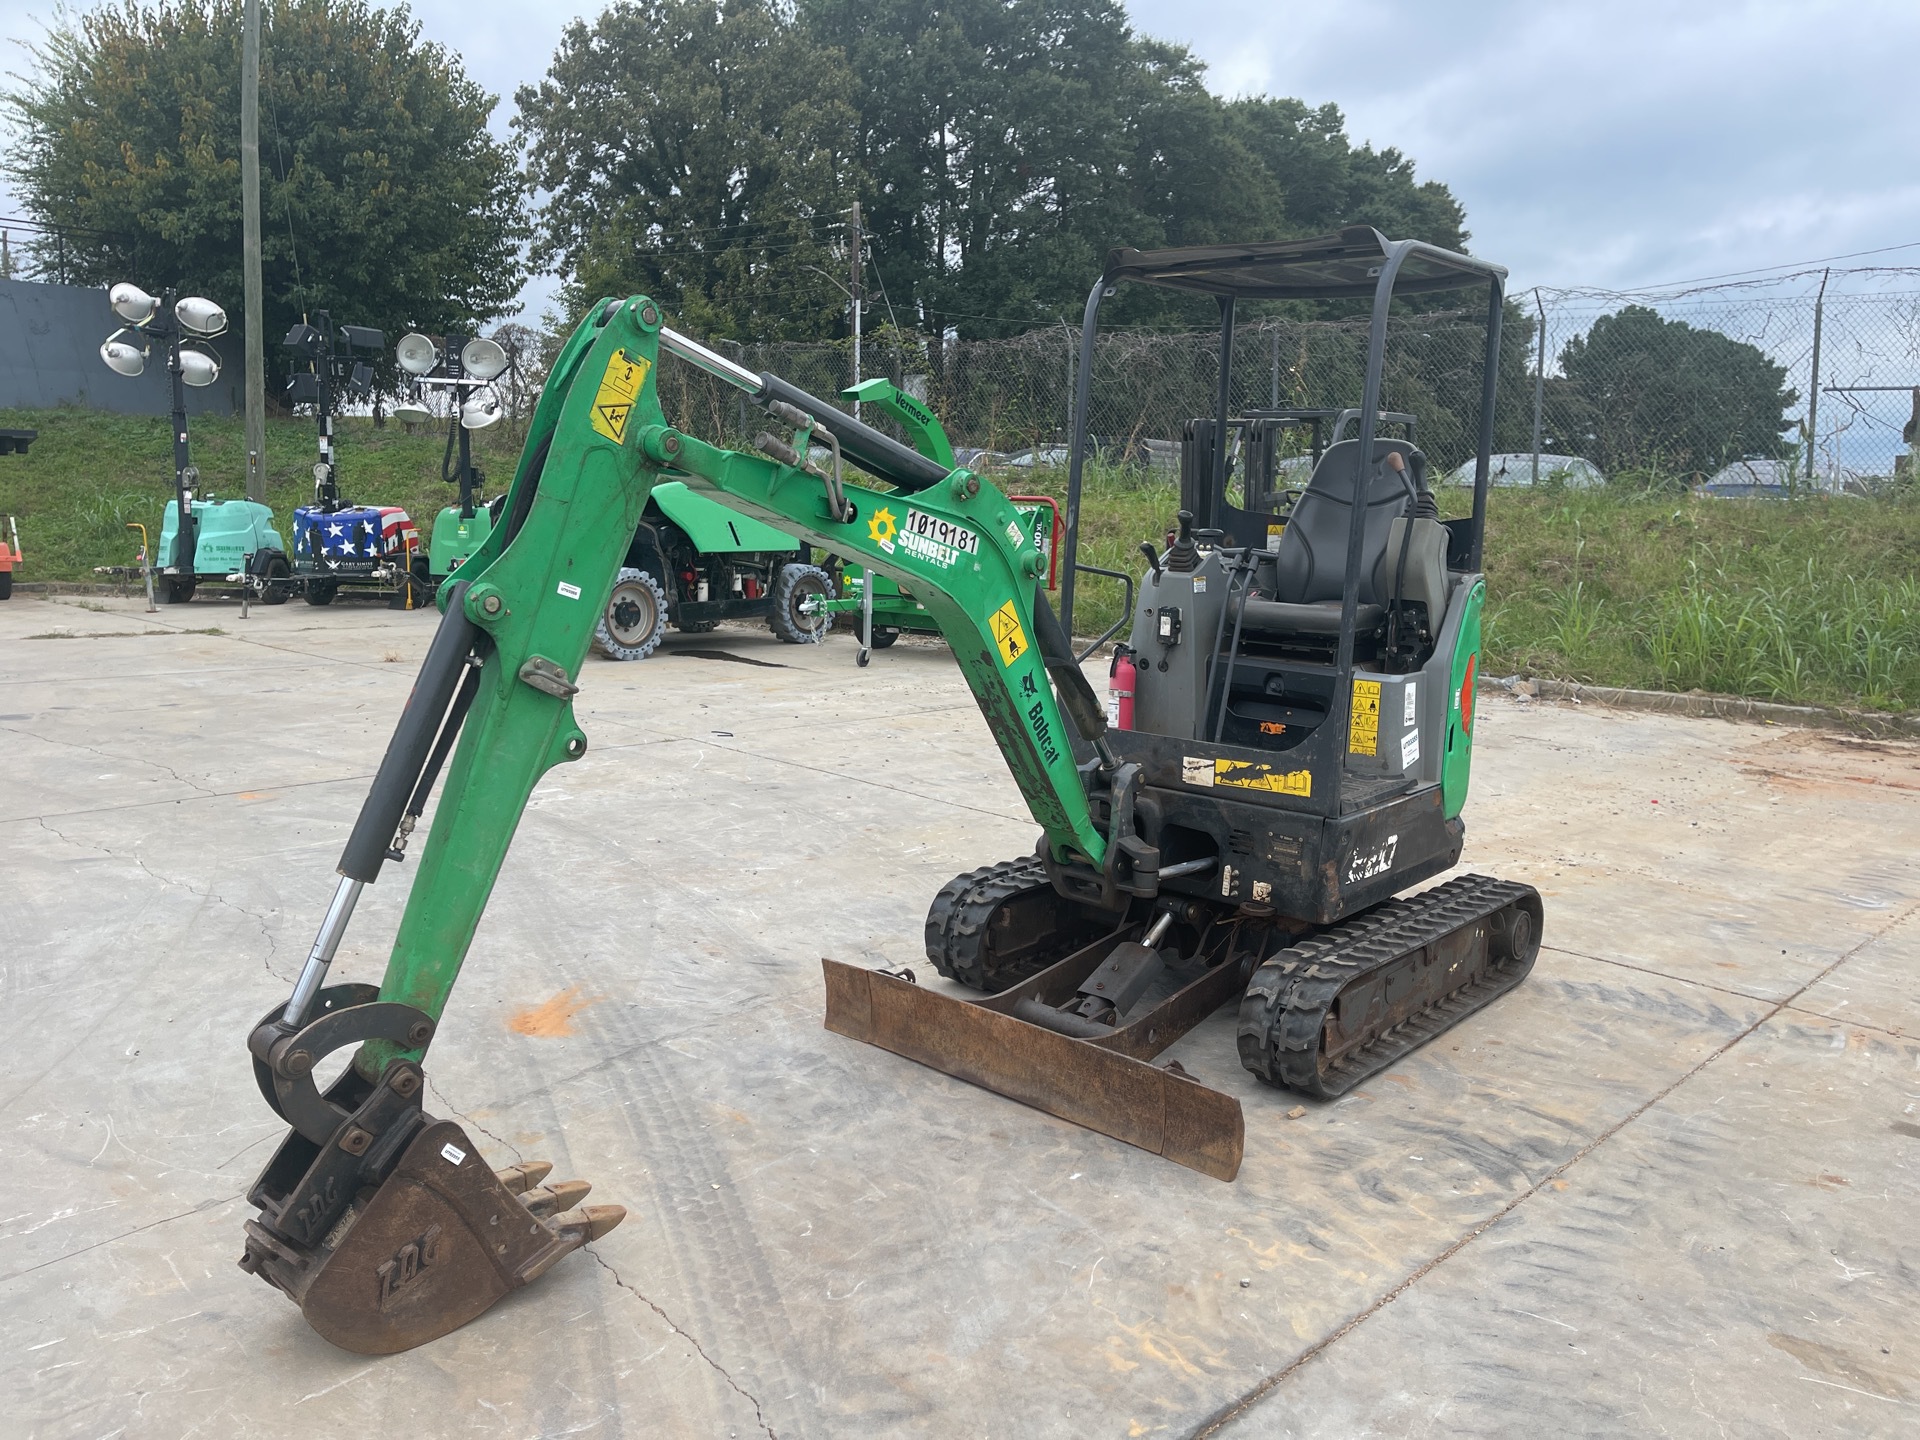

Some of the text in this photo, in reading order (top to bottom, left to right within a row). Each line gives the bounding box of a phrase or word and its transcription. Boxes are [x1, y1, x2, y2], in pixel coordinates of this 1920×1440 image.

[895, 391, 932, 427] Vermeer
[897, 529, 960, 566] SUNBELT
[908, 511, 978, 554] 1019181
[904, 548, 949, 570] RENTALS
[1028, 700, 1061, 769] Bobcat
